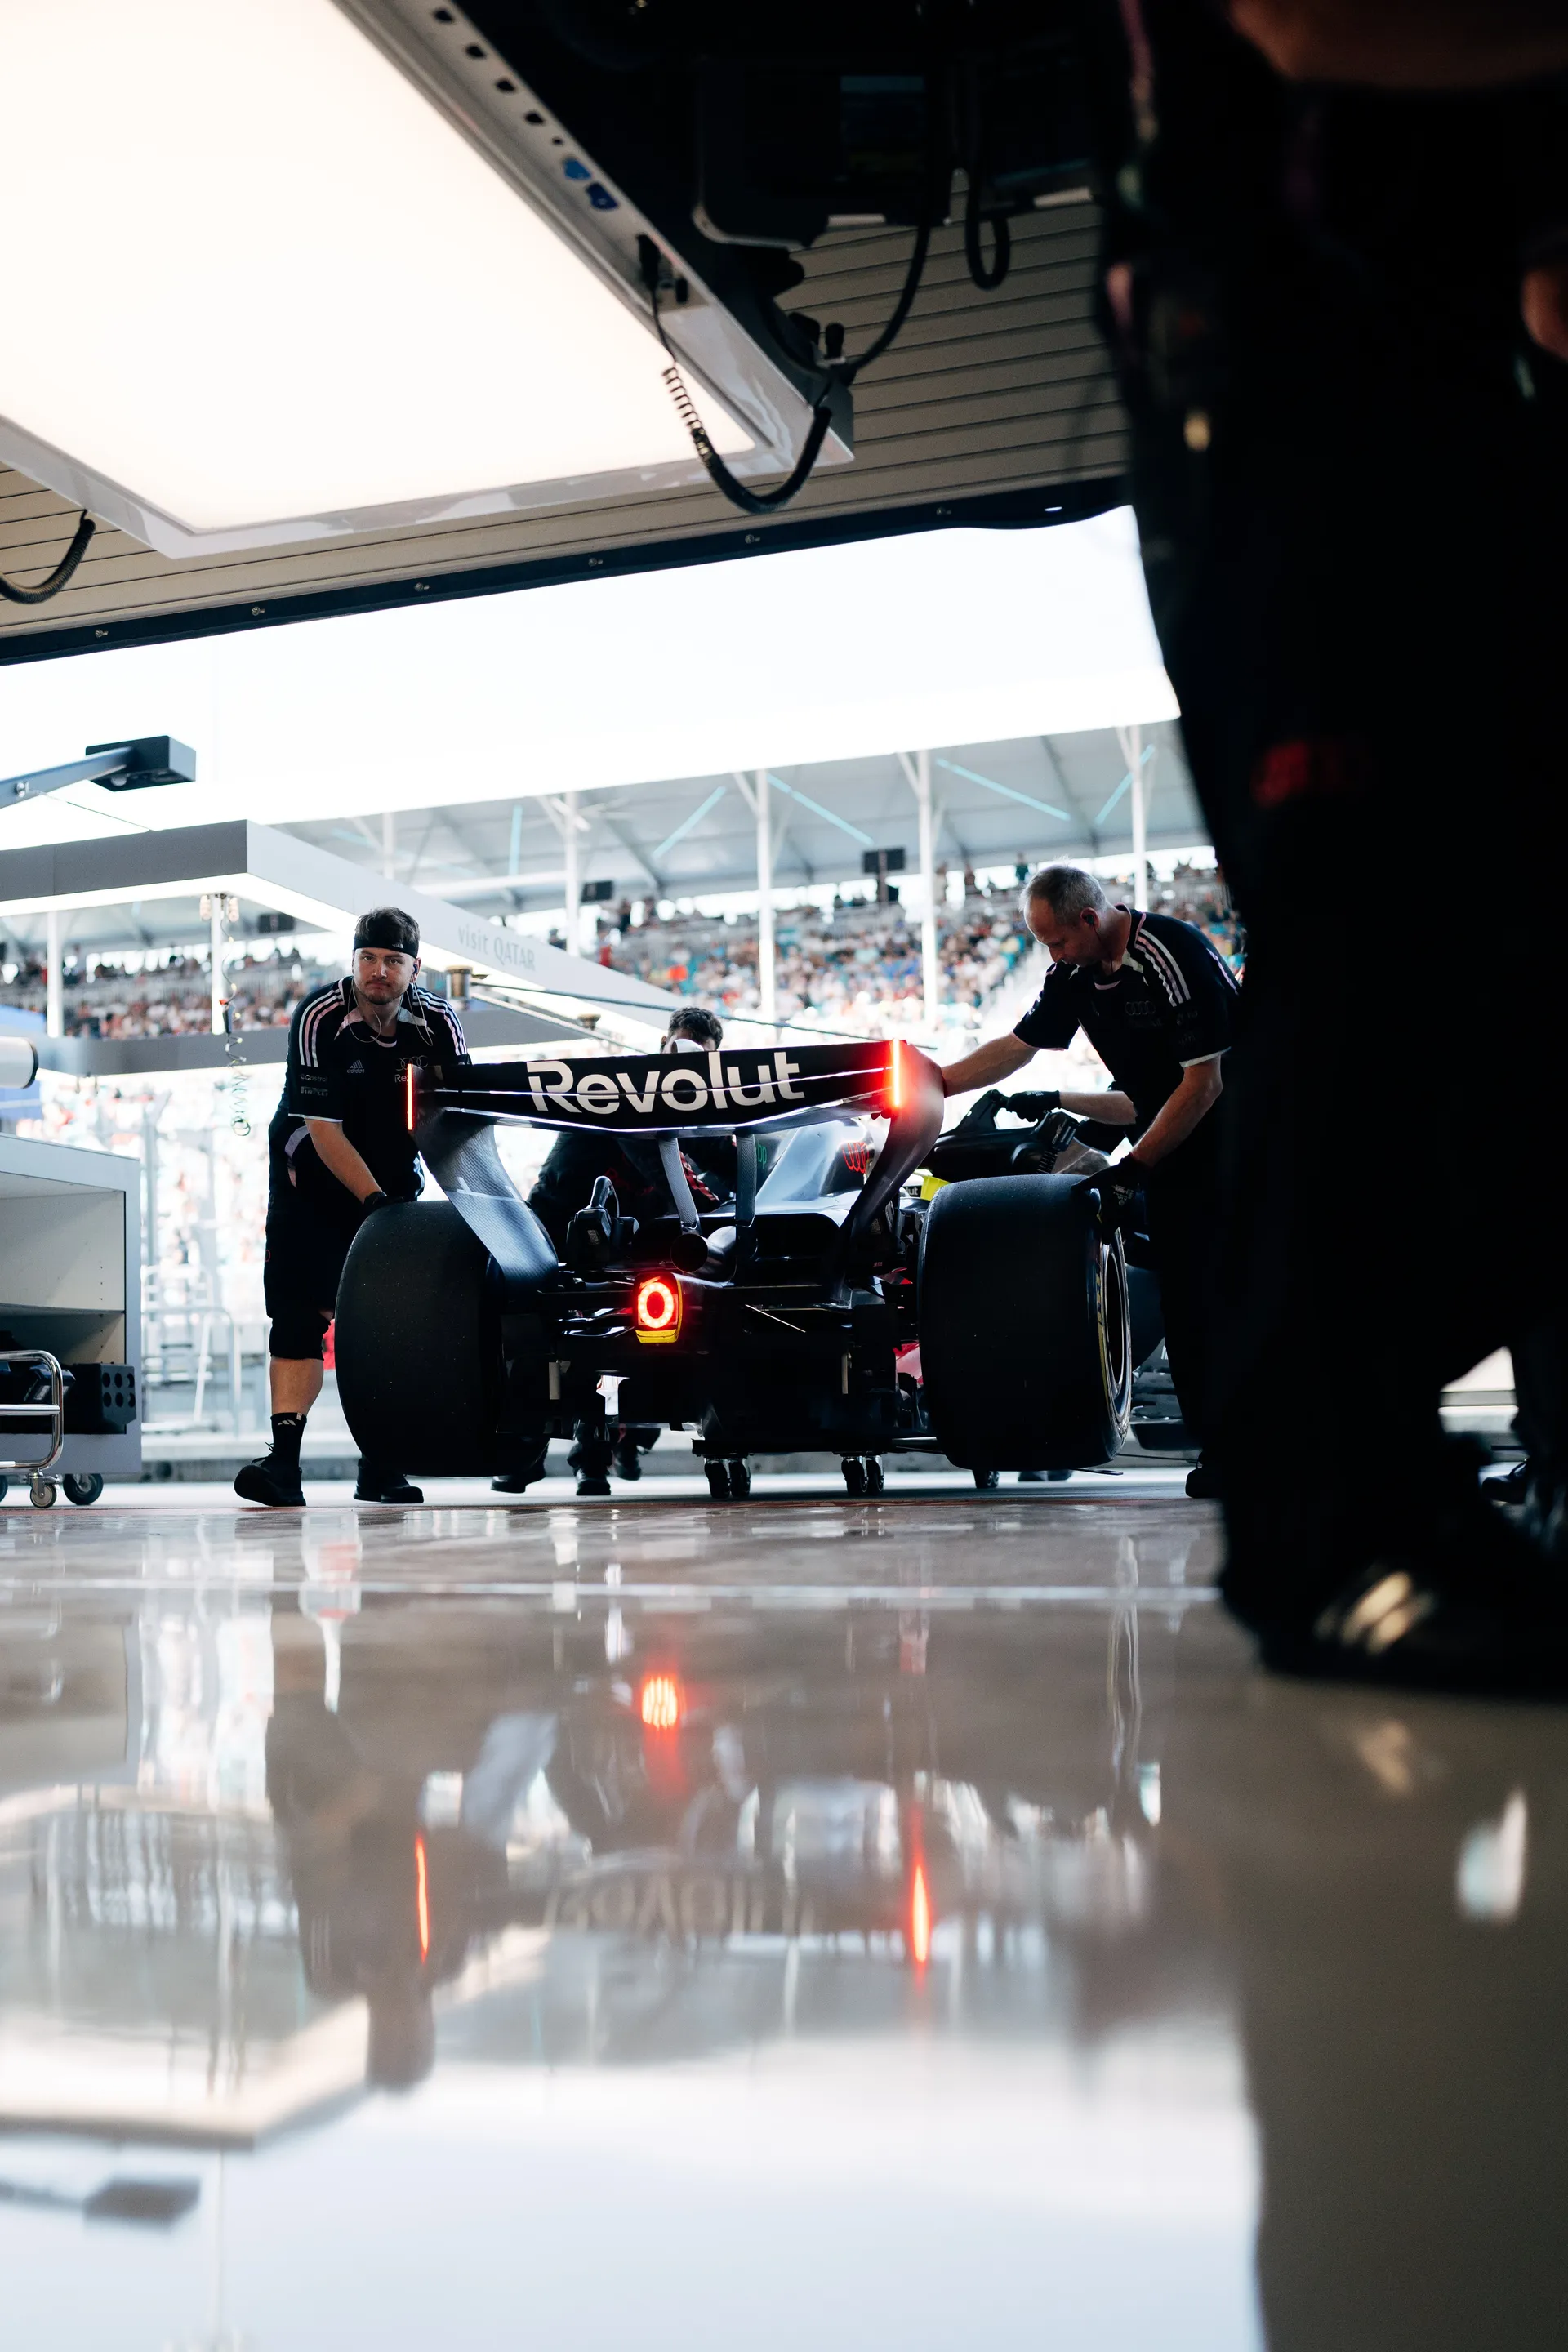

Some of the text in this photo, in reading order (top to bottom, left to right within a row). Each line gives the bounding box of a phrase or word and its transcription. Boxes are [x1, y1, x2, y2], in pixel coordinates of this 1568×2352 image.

[457, 924, 536, 971] visit QATAR
[305, 1074, 328, 1083] Castrol
[526, 1051, 805, 1115] Revolut
